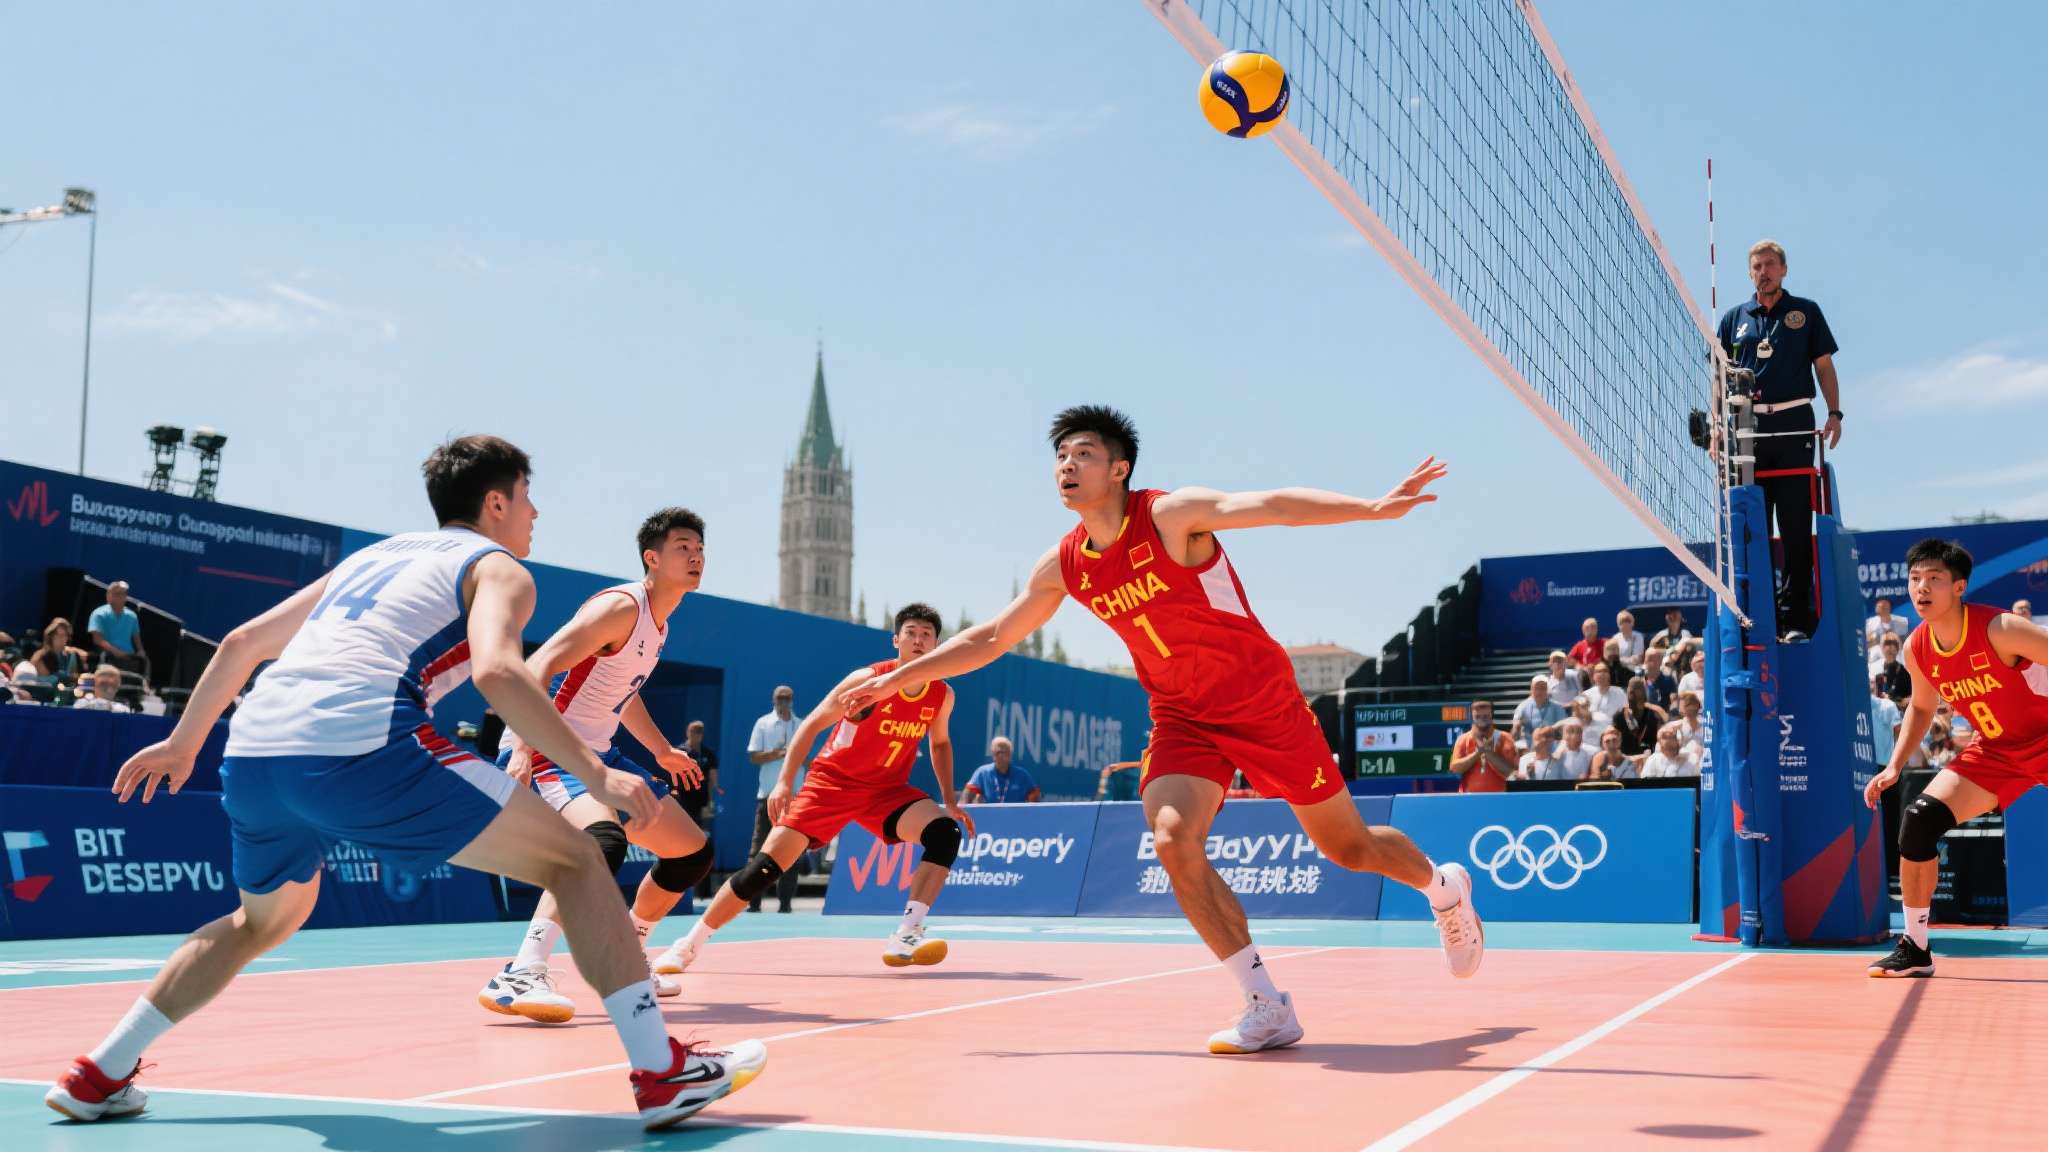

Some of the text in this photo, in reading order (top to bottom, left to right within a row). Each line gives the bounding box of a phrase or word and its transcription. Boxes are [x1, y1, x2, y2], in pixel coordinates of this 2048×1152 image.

[309, 558, 415, 621] 14
[1091, 571, 1171, 620] CHINA
[1132, 613, 1172, 659] 1
[1939, 673, 2003, 703] CHINA
[879, 719, 927, 738] CHINA
[1969, 701, 2004, 739] 8
[884, 740, 904, 768] 7
[75, 828, 126, 857] BIT
